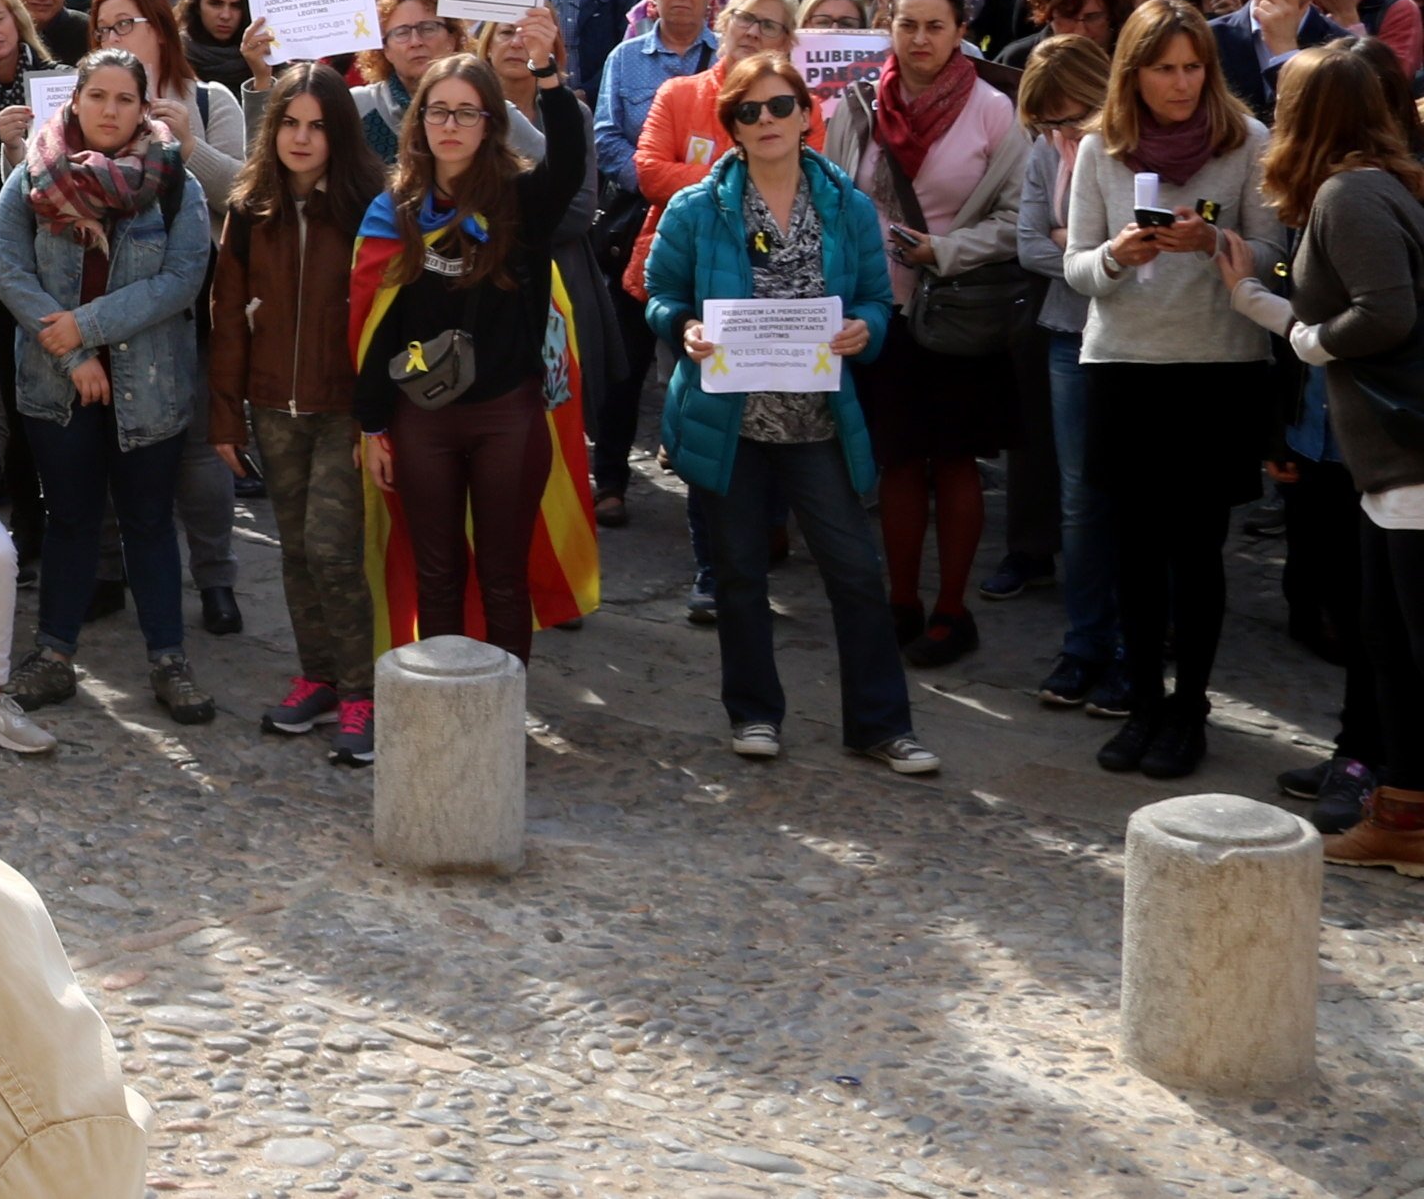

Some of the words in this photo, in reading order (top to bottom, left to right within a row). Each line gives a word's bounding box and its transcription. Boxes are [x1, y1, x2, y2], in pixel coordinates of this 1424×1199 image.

[805, 66, 881, 83] PRESO
[722, 308, 764, 316] REBUTGEM
[720, 317, 752, 325] JUDICIAL
[730, 348, 743, 356] NO
[745, 348, 772, 356] ESTEU
[774, 348, 805, 357] SOL@S
